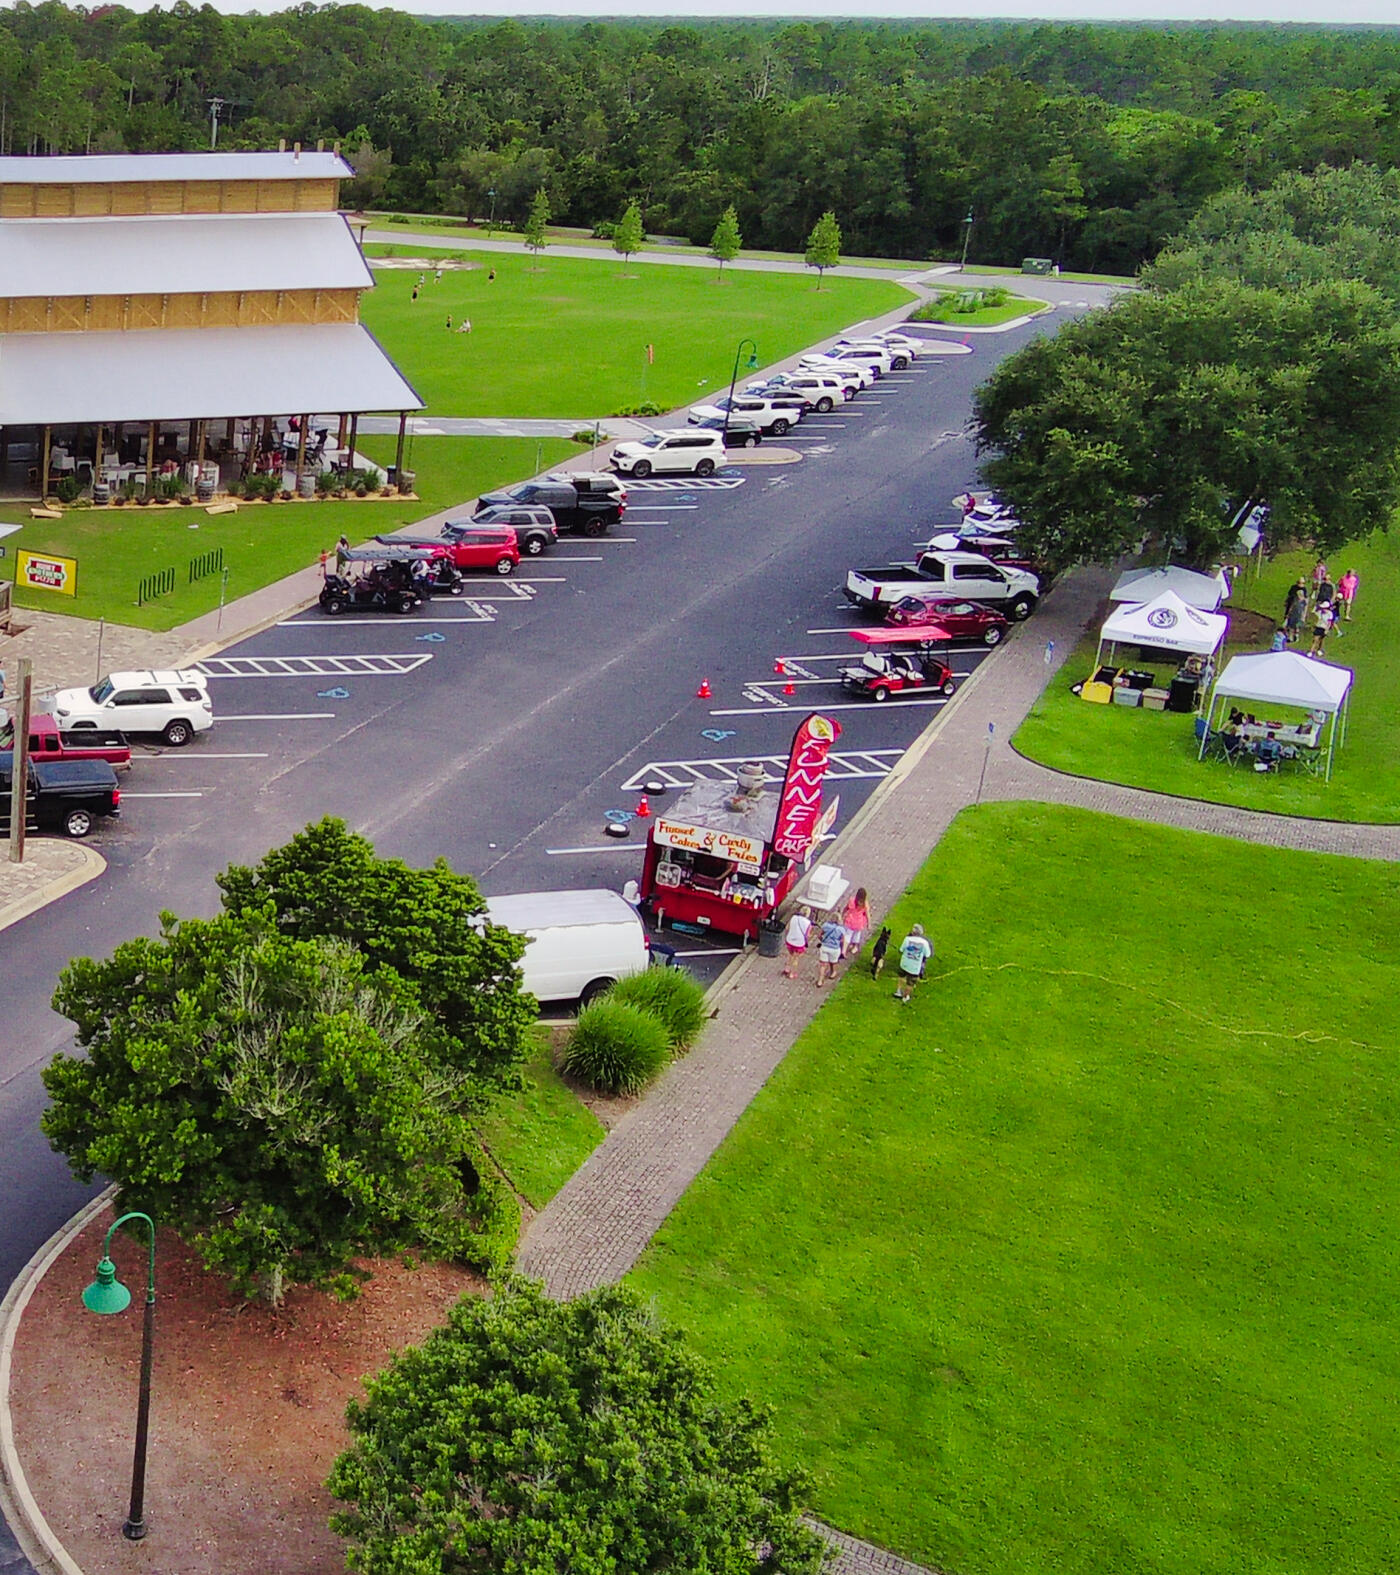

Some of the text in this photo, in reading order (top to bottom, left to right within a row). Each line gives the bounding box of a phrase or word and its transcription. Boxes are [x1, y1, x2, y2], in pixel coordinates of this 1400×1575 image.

[784, 739, 827, 840] FUNNEL
[719, 834, 752, 850] Curly
[728, 847, 758, 863] Fries
